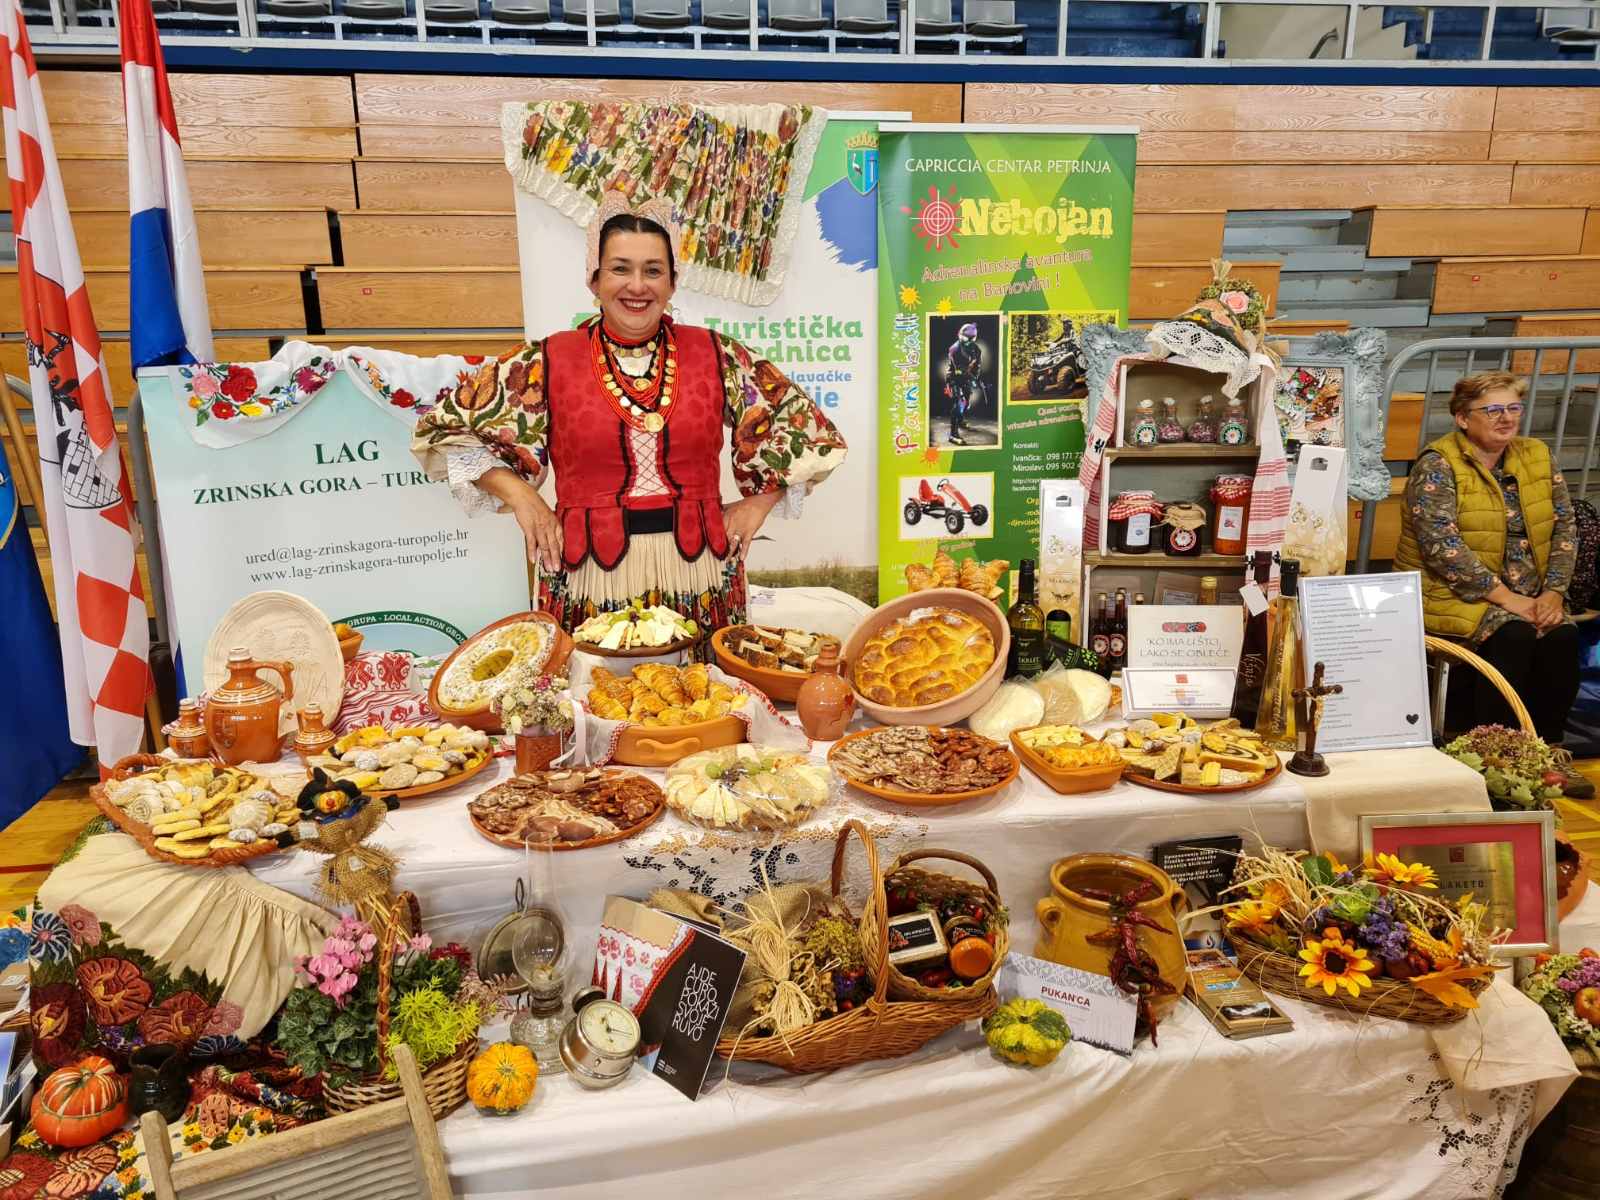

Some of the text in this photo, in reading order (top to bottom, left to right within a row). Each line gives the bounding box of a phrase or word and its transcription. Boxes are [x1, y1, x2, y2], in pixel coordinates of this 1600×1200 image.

[905, 158, 1112, 174] CAPRICCIA CENTAR PETRINJA
[704, 315, 864, 339] Turistička
[895, 313, 921, 454] Paintball
[314, 439, 380, 466] LAG
[193, 482, 294, 506] ZRINSKA
[299, 473, 362, 496] GORA
[245, 528, 469, 565] ured@lag-zrinskagora-turopolje.hr
[250, 546, 469, 584] www.lag-zrinskagora-turopolje.hr
[383, 613, 413, 622] LOCAL
[414, 615, 446, 630] ACTION
[684, 975, 717, 1002] CURO
[688, 962, 717, 987] AJDE
[680, 987, 720, 1021] POKAŽI
[1040, 985, 1091, 1007] PUKAN'CA
[671, 1010, 703, 1041] RUVO
[678, 1001, 710, 1030] SVOJE
